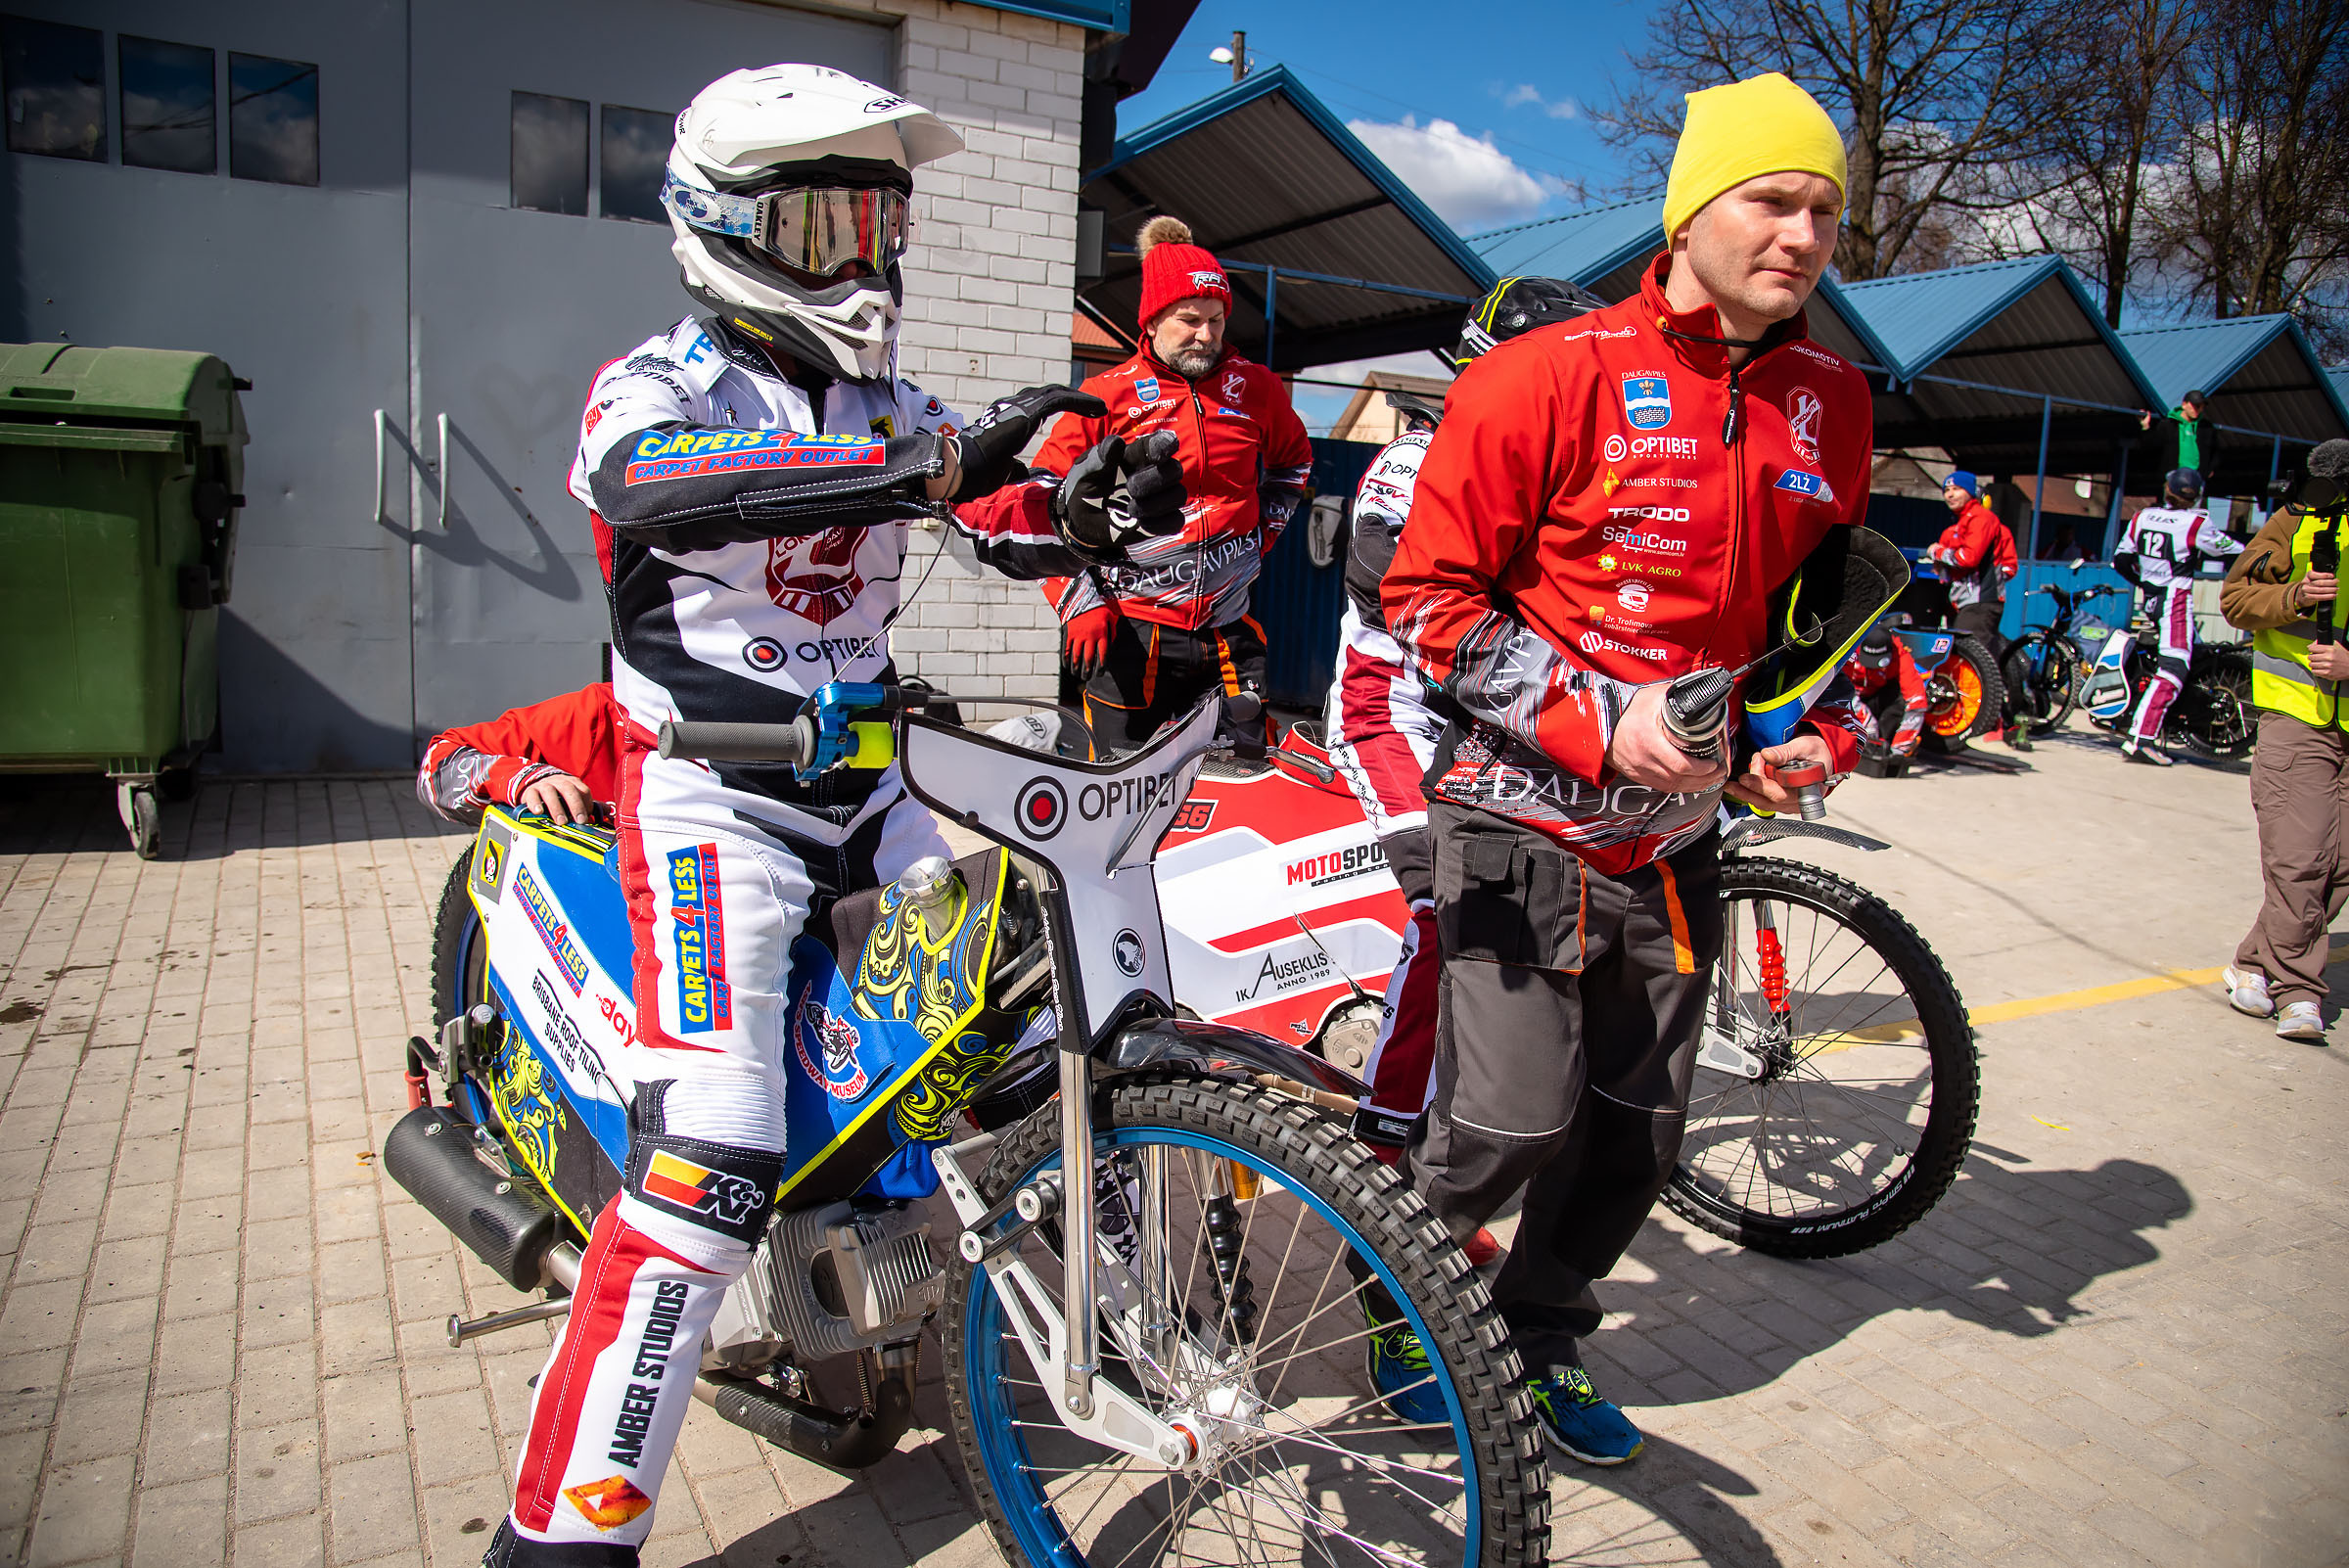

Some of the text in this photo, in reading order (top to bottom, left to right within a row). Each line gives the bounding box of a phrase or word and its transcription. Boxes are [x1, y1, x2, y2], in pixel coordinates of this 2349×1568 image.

[872, 98, 905, 110] SH
[753, 202, 764, 242] OAKLEY
[1622, 370, 1666, 379] DAUGAVPILS
[1142, 399, 1176, 410] OPTIBET
[637, 432, 764, 457] CARPETS
[768, 433, 798, 447] 4
[1631, 437, 1698, 455] OPTIBET
[634, 448, 873, 479] CARPET FACTORY OUTLET
[1622, 478, 1698, 488] AMBER STUDIOS
[1788, 474, 1811, 491] 2LŻ
[1608, 507, 1689, 522] TRODO
[1602, 527, 1686, 551] SemiCom
[2142, 531, 2164, 557] 12
[1121, 530, 1257, 591] DAUGAVPILS
[1622, 562, 1681, 576] LVK AGRO
[1618, 618, 1652, 628] Trofimova
[796, 636, 881, 663] OPTIBET
[1603, 639, 1668, 661] STOKKER
[1025, 717, 1044, 732] OEI
[1079, 773, 1178, 821] OPTIBET
[1493, 764, 1700, 815] DAUGA
[704, 852, 718, 899] OUTLET
[1287, 842, 1388, 886] MOTOSPO
[1315, 863, 1390, 885] racing tea
[673, 857, 697, 900] LESS
[519, 868, 587, 980] CARPETS 4 LESS
[670, 904, 706, 926] 4
[513, 885, 580, 993] CARPET FACTORY OUTLET
[707, 904, 722, 967] FACTORY
[1276, 969, 1330, 991] ANNO 1989
[1236, 989, 1251, 1002] IK
[532, 975, 561, 1028] BRISBANE
[560, 1021, 579, 1052] ROOF
[545, 1023, 576, 1073] SUPPLIES
[795, 1023, 866, 1097] SPEEDWAY MUSEUM
[694, 1172, 764, 1223] K&N
[608, 1280, 689, 1469] AMBER STUDIOS
